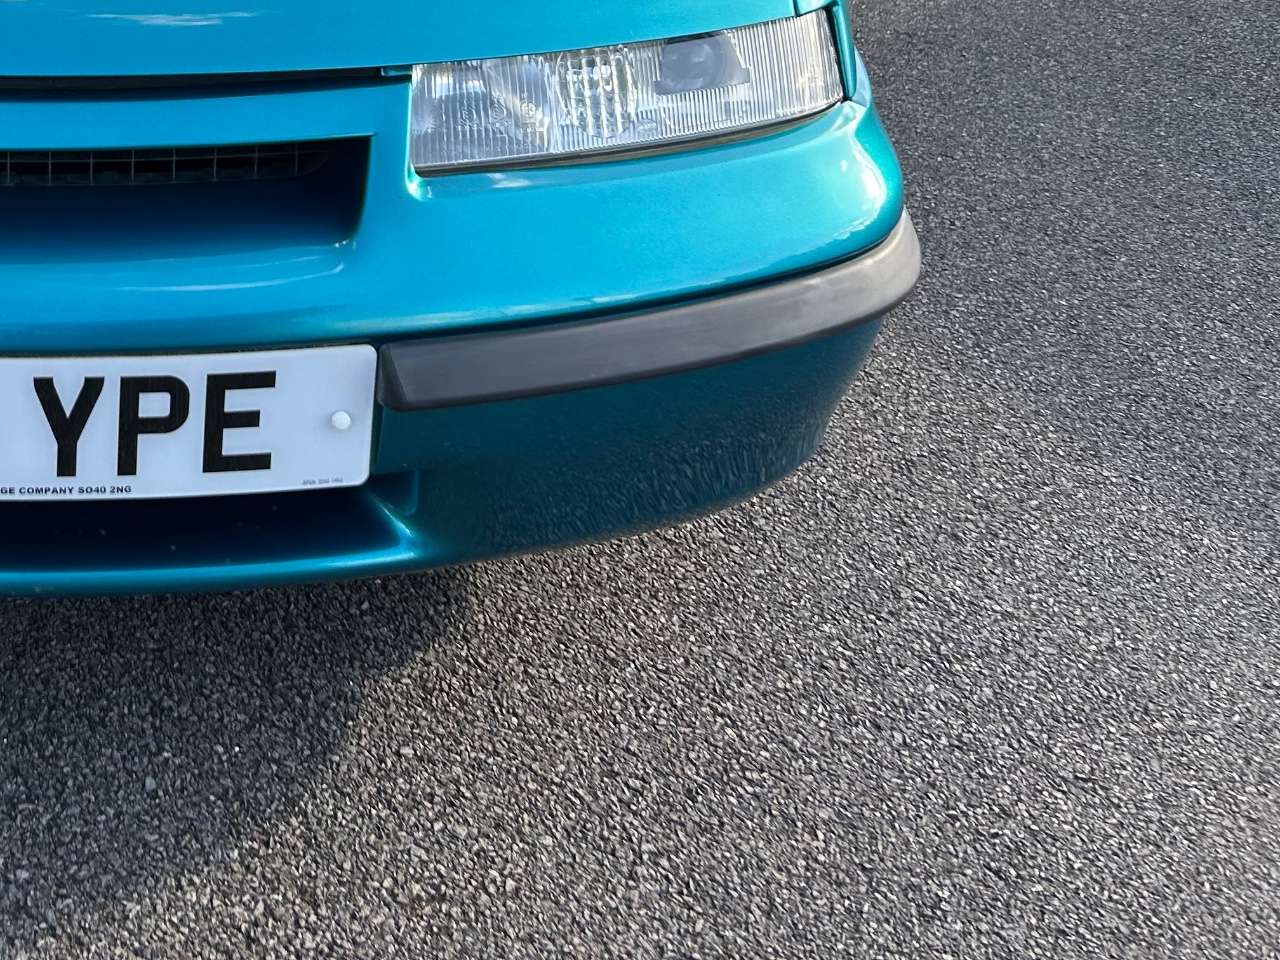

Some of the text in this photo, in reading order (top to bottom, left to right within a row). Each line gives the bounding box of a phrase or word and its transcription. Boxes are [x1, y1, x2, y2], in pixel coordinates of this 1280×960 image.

[33, 370, 277, 477] YPE
[19, 486, 74, 495] COMPANY
[109, 485, 132, 494] 2NG
